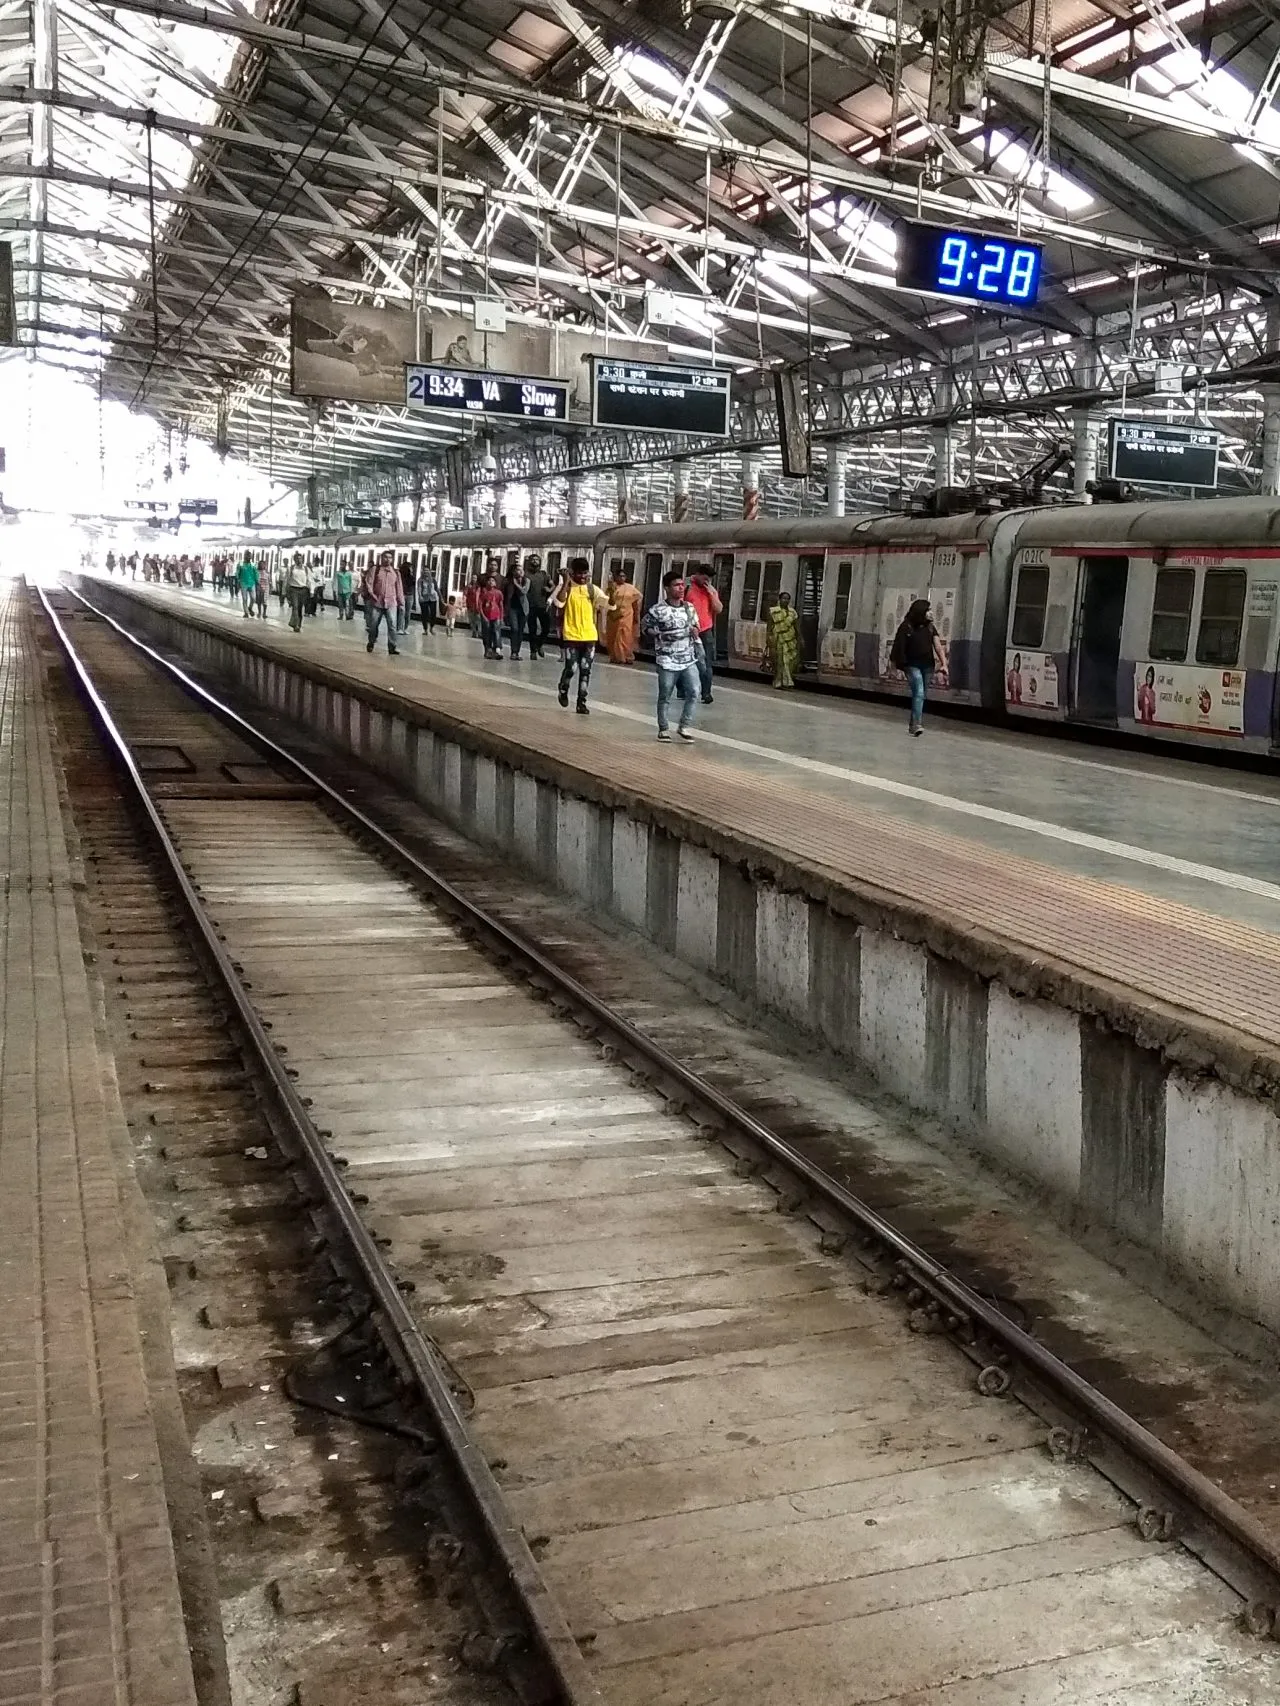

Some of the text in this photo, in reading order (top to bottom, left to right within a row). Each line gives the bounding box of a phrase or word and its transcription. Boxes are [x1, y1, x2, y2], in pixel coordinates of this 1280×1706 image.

[938, 237, 1035, 297] 9:28
[602, 366, 625, 378] 9:30
[691, 375, 701, 386] 12
[408, 375, 557, 407] 2 9:34 VA Slow
[1121, 428, 1139, 439] 9:30
